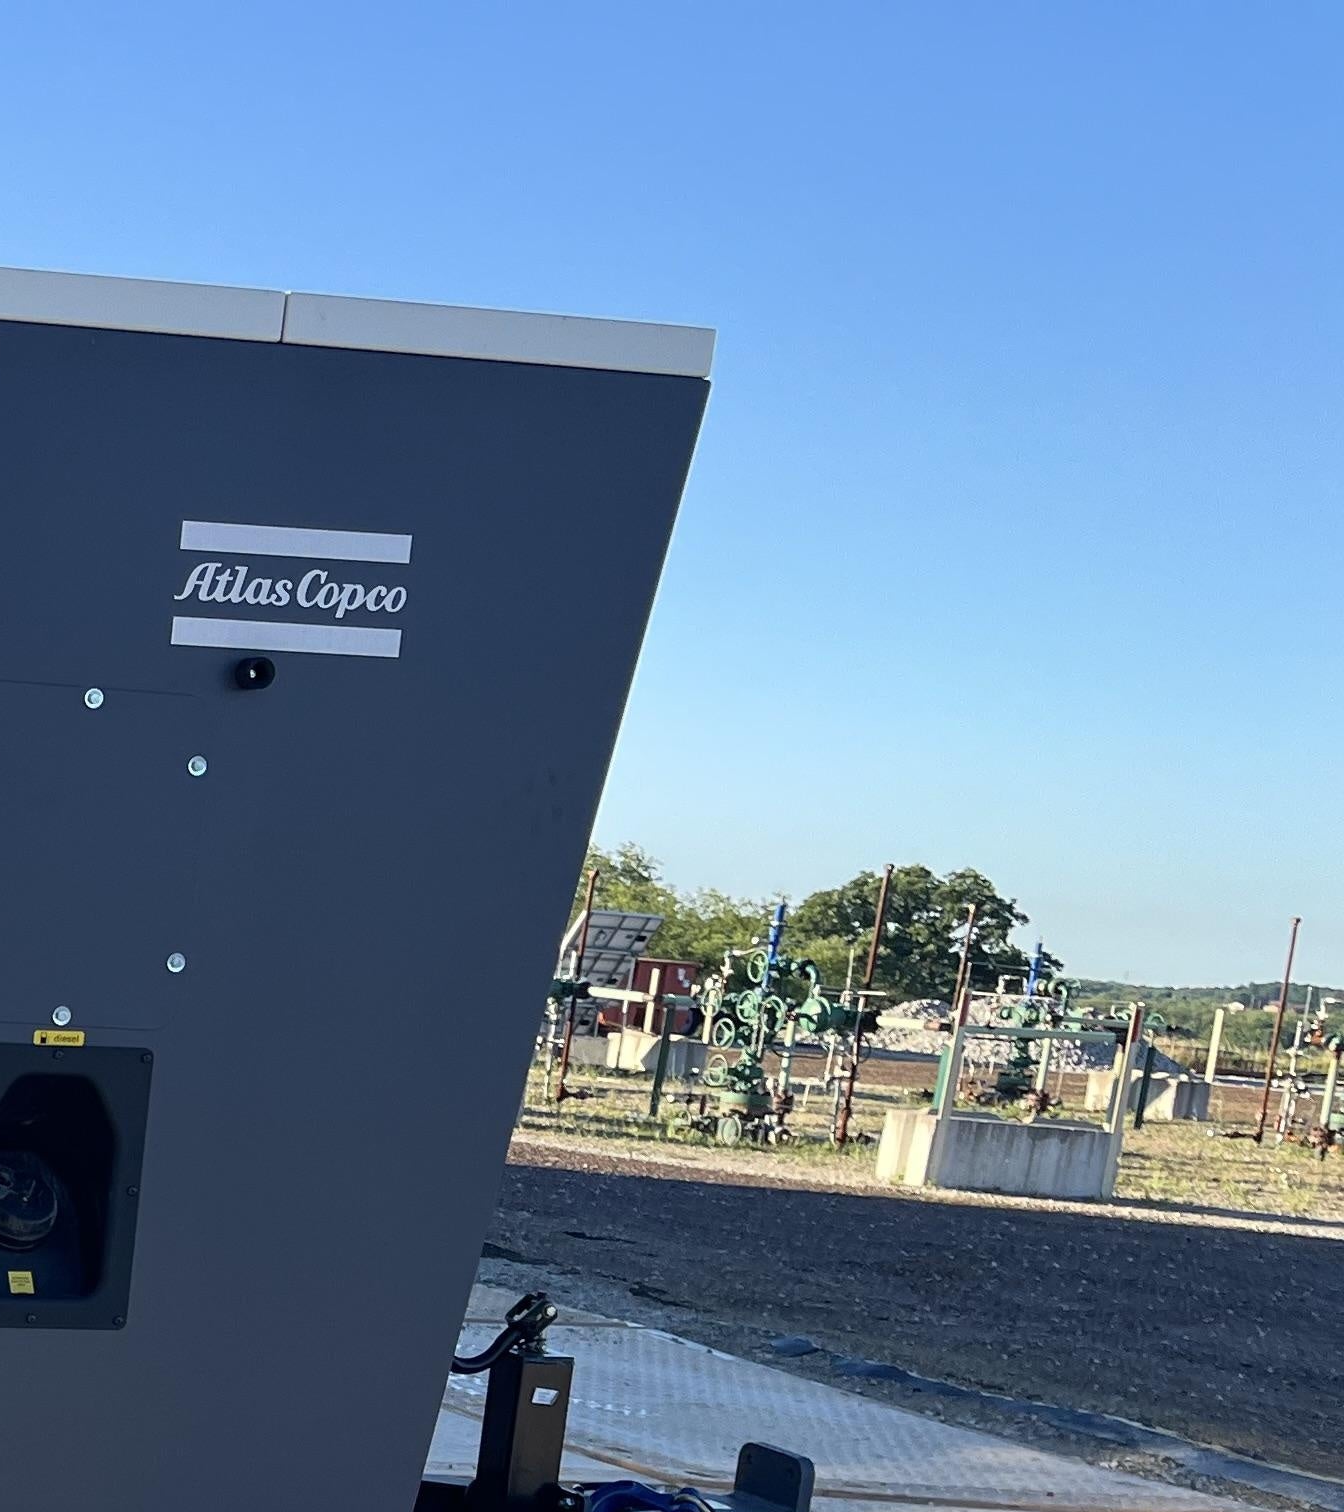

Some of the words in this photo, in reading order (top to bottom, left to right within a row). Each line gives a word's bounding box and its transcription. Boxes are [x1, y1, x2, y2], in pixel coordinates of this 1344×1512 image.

[173, 562, 293, 607] Atlas
[297, 569, 408, 619] Copco
[53, 1034, 80, 1043] diesel
